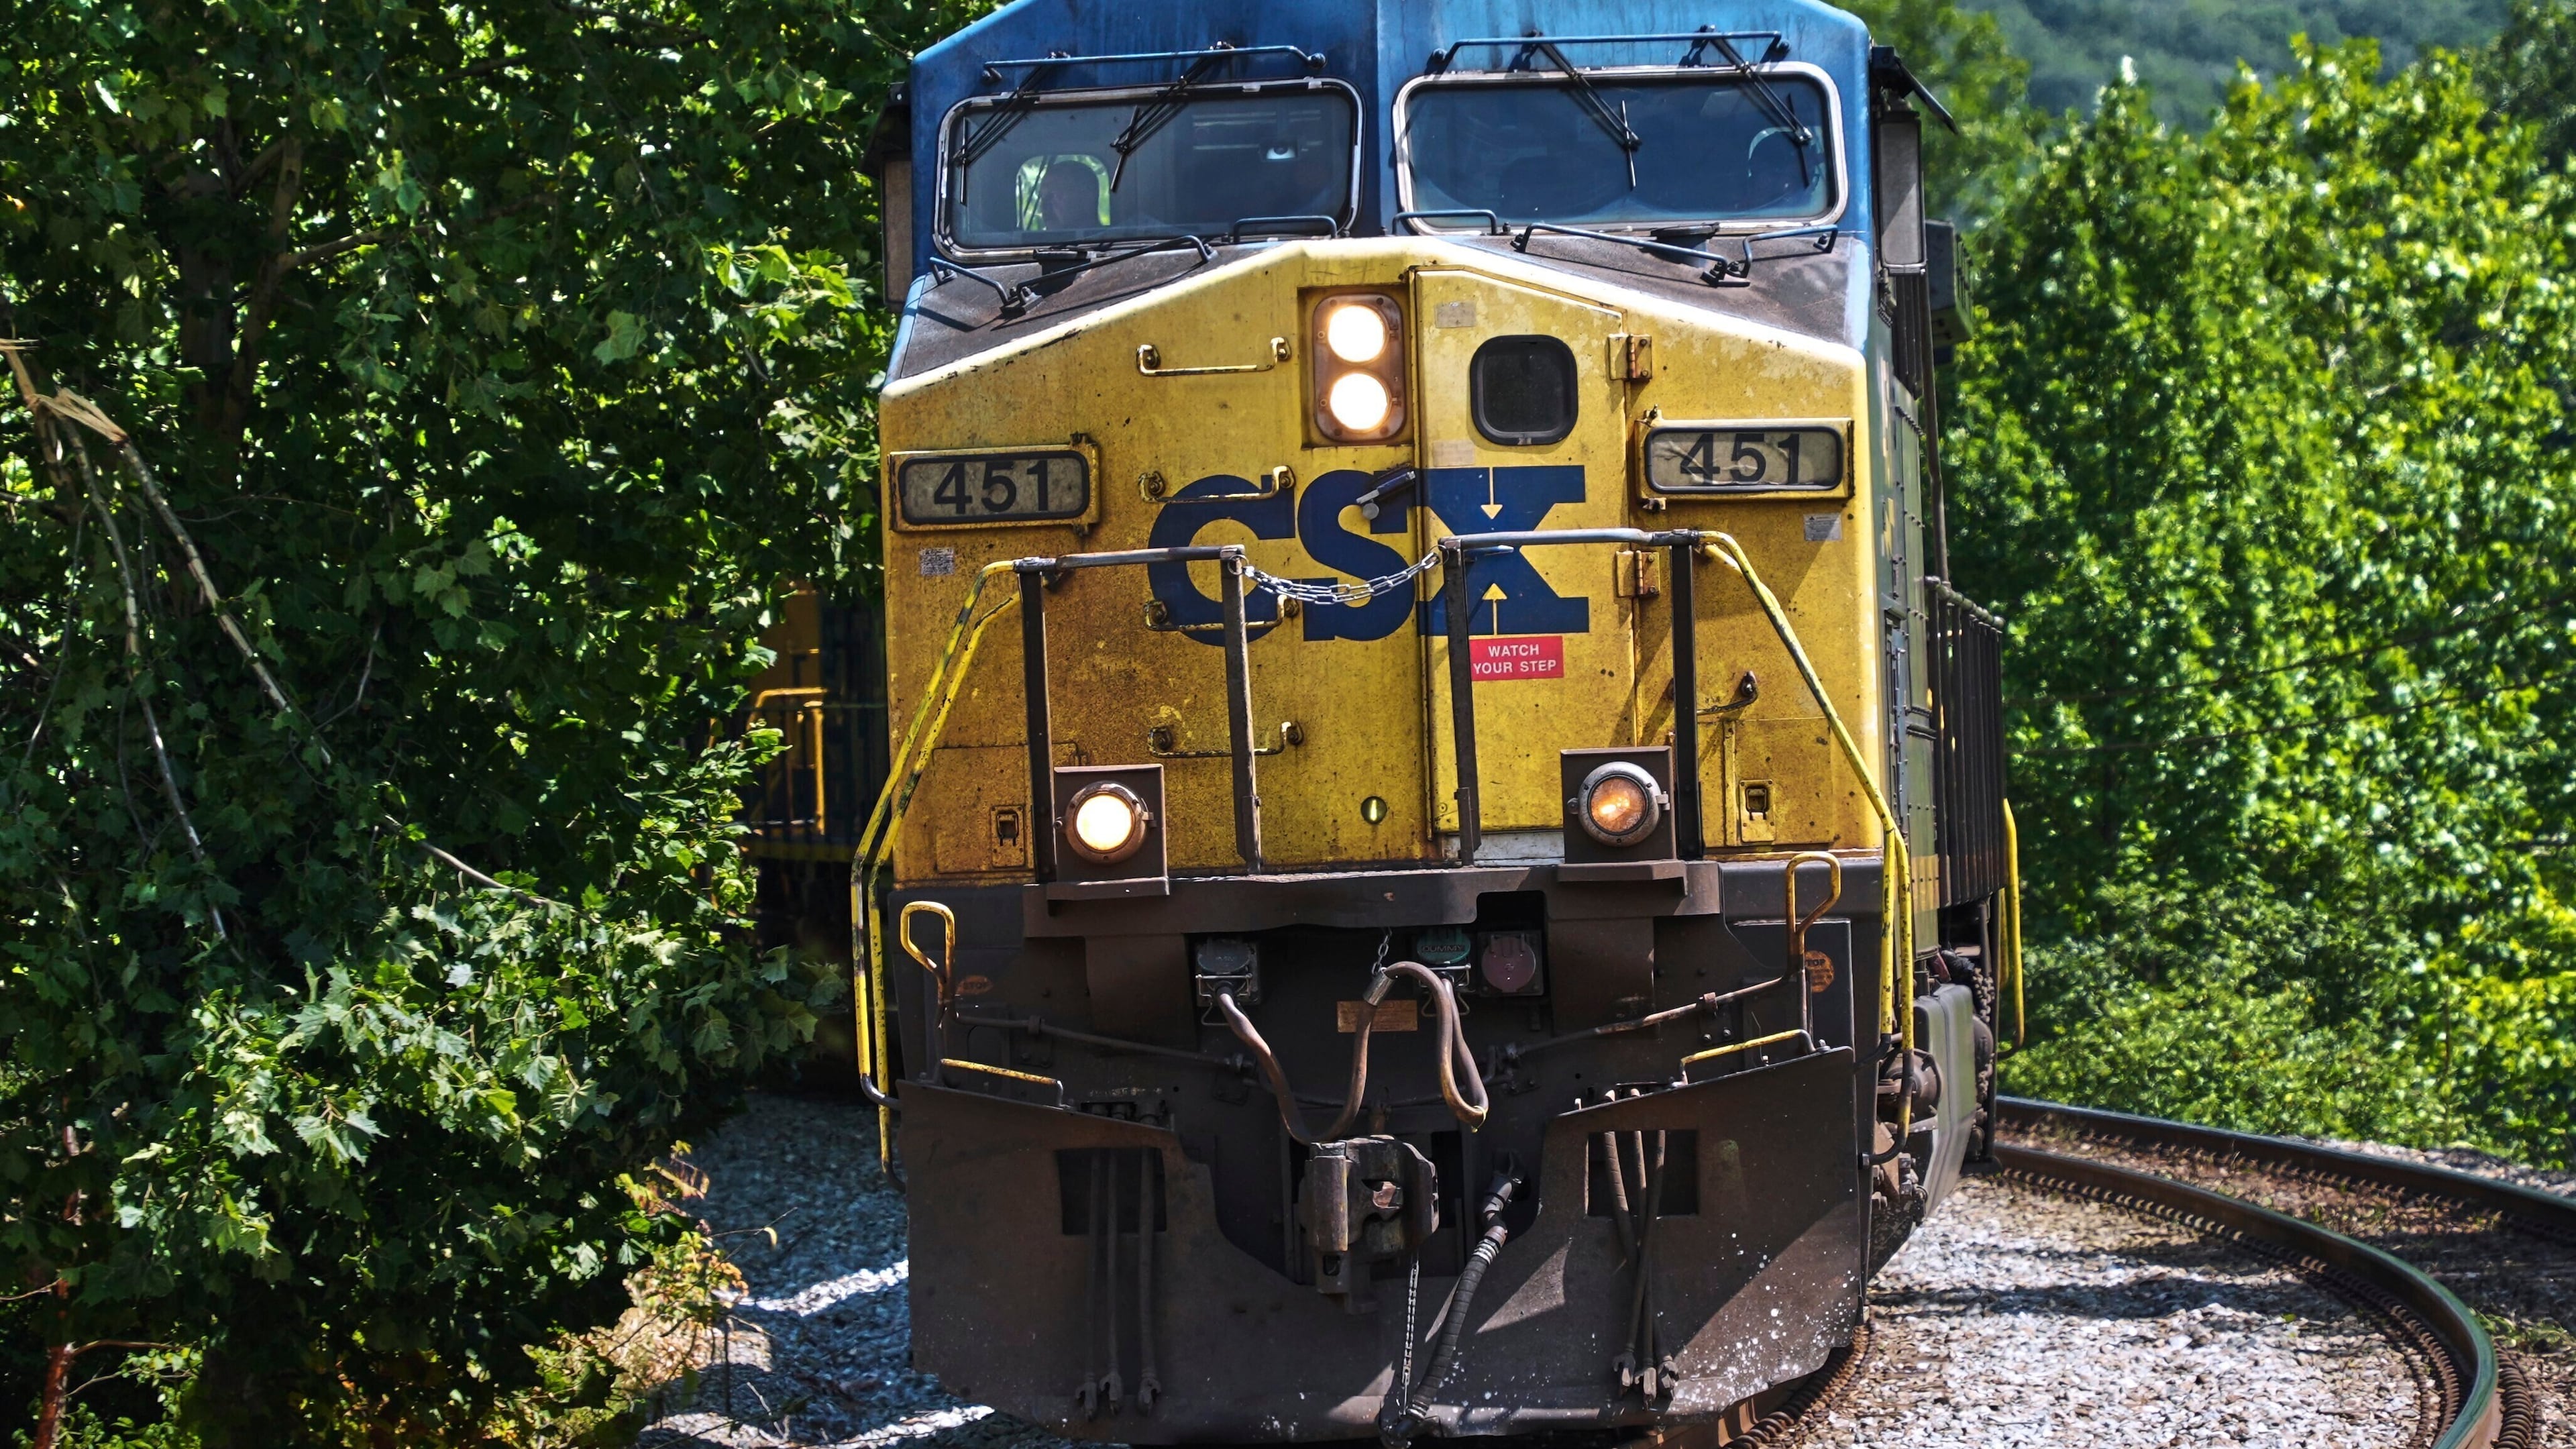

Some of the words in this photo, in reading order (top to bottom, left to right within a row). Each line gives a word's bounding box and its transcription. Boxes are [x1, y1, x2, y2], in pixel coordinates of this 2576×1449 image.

[1680, 433, 1801, 484] 451
[934, 460, 1049, 514] 451
[1147, 465, 1589, 647] CSX
[1488, 644, 1539, 657] WATCH
[1473, 662, 1513, 674] YOUR
[1520, 659, 1556, 672] STEP
[1421, 944, 1464, 953] DUMMY
[1805, 959, 1826, 967] TOP
